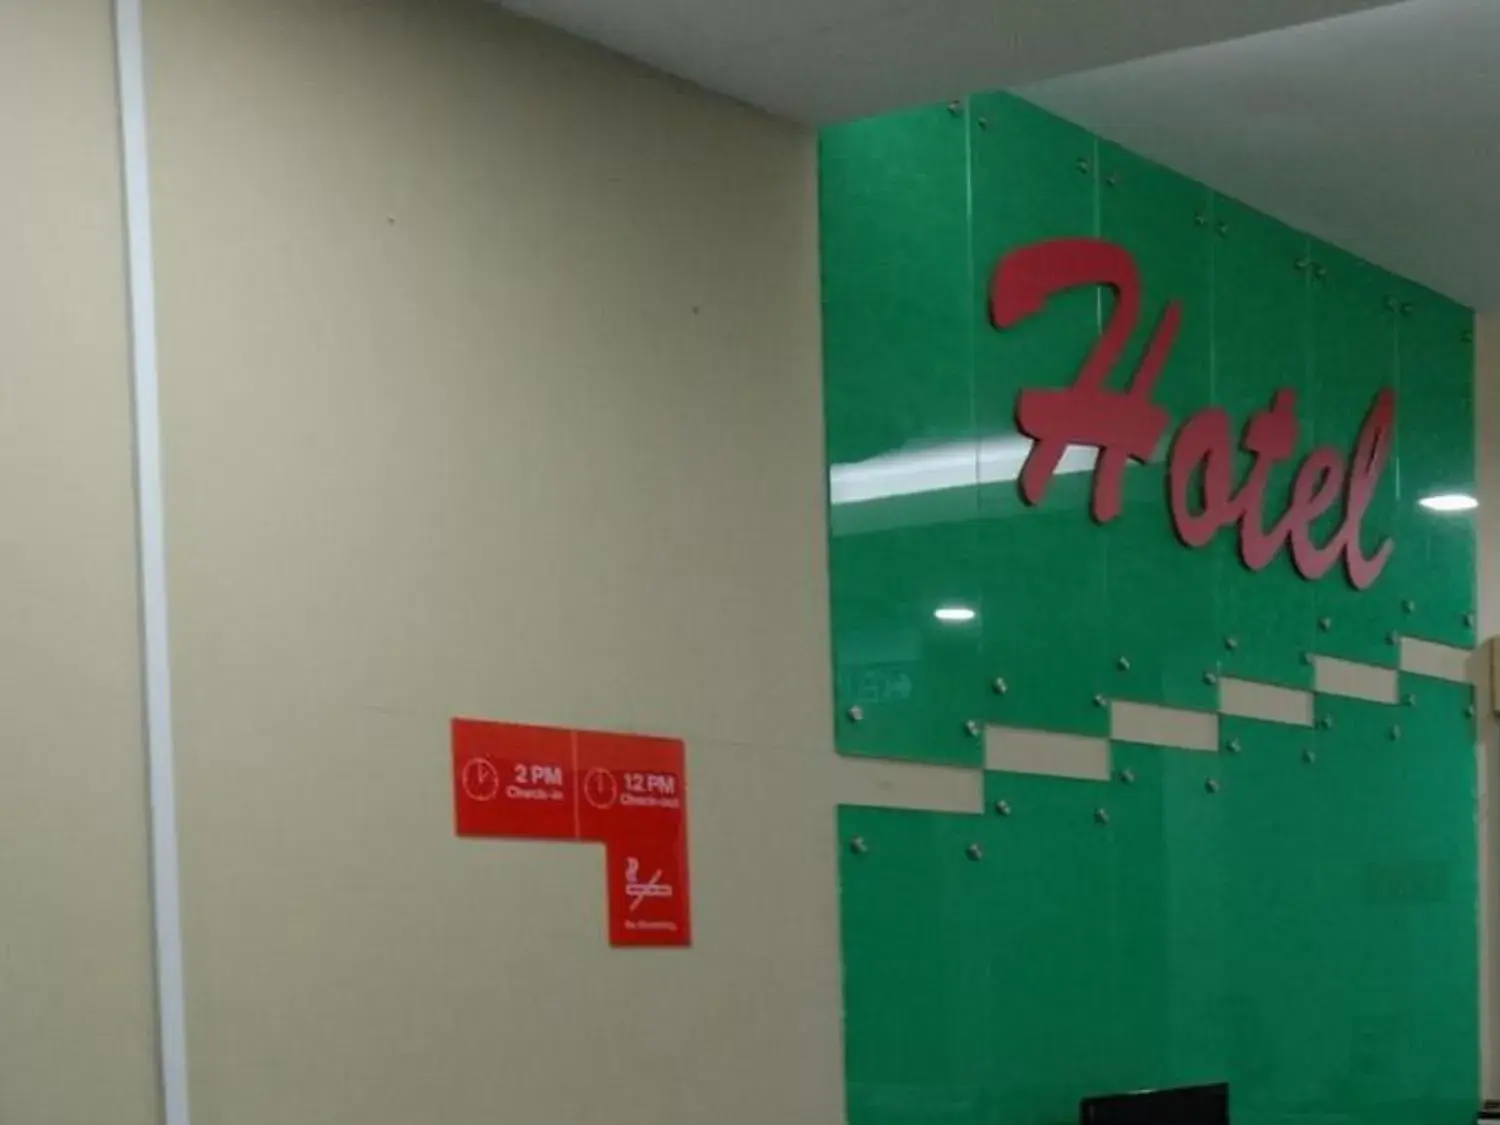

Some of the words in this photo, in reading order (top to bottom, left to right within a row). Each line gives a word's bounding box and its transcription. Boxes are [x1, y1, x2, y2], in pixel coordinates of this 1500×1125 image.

[988, 237, 1397, 591] Hotel
[514, 763, 527, 784] 2
[531, 765, 563, 787] PM
[624, 772, 644, 793] 12
[647, 774, 676, 796] PM
